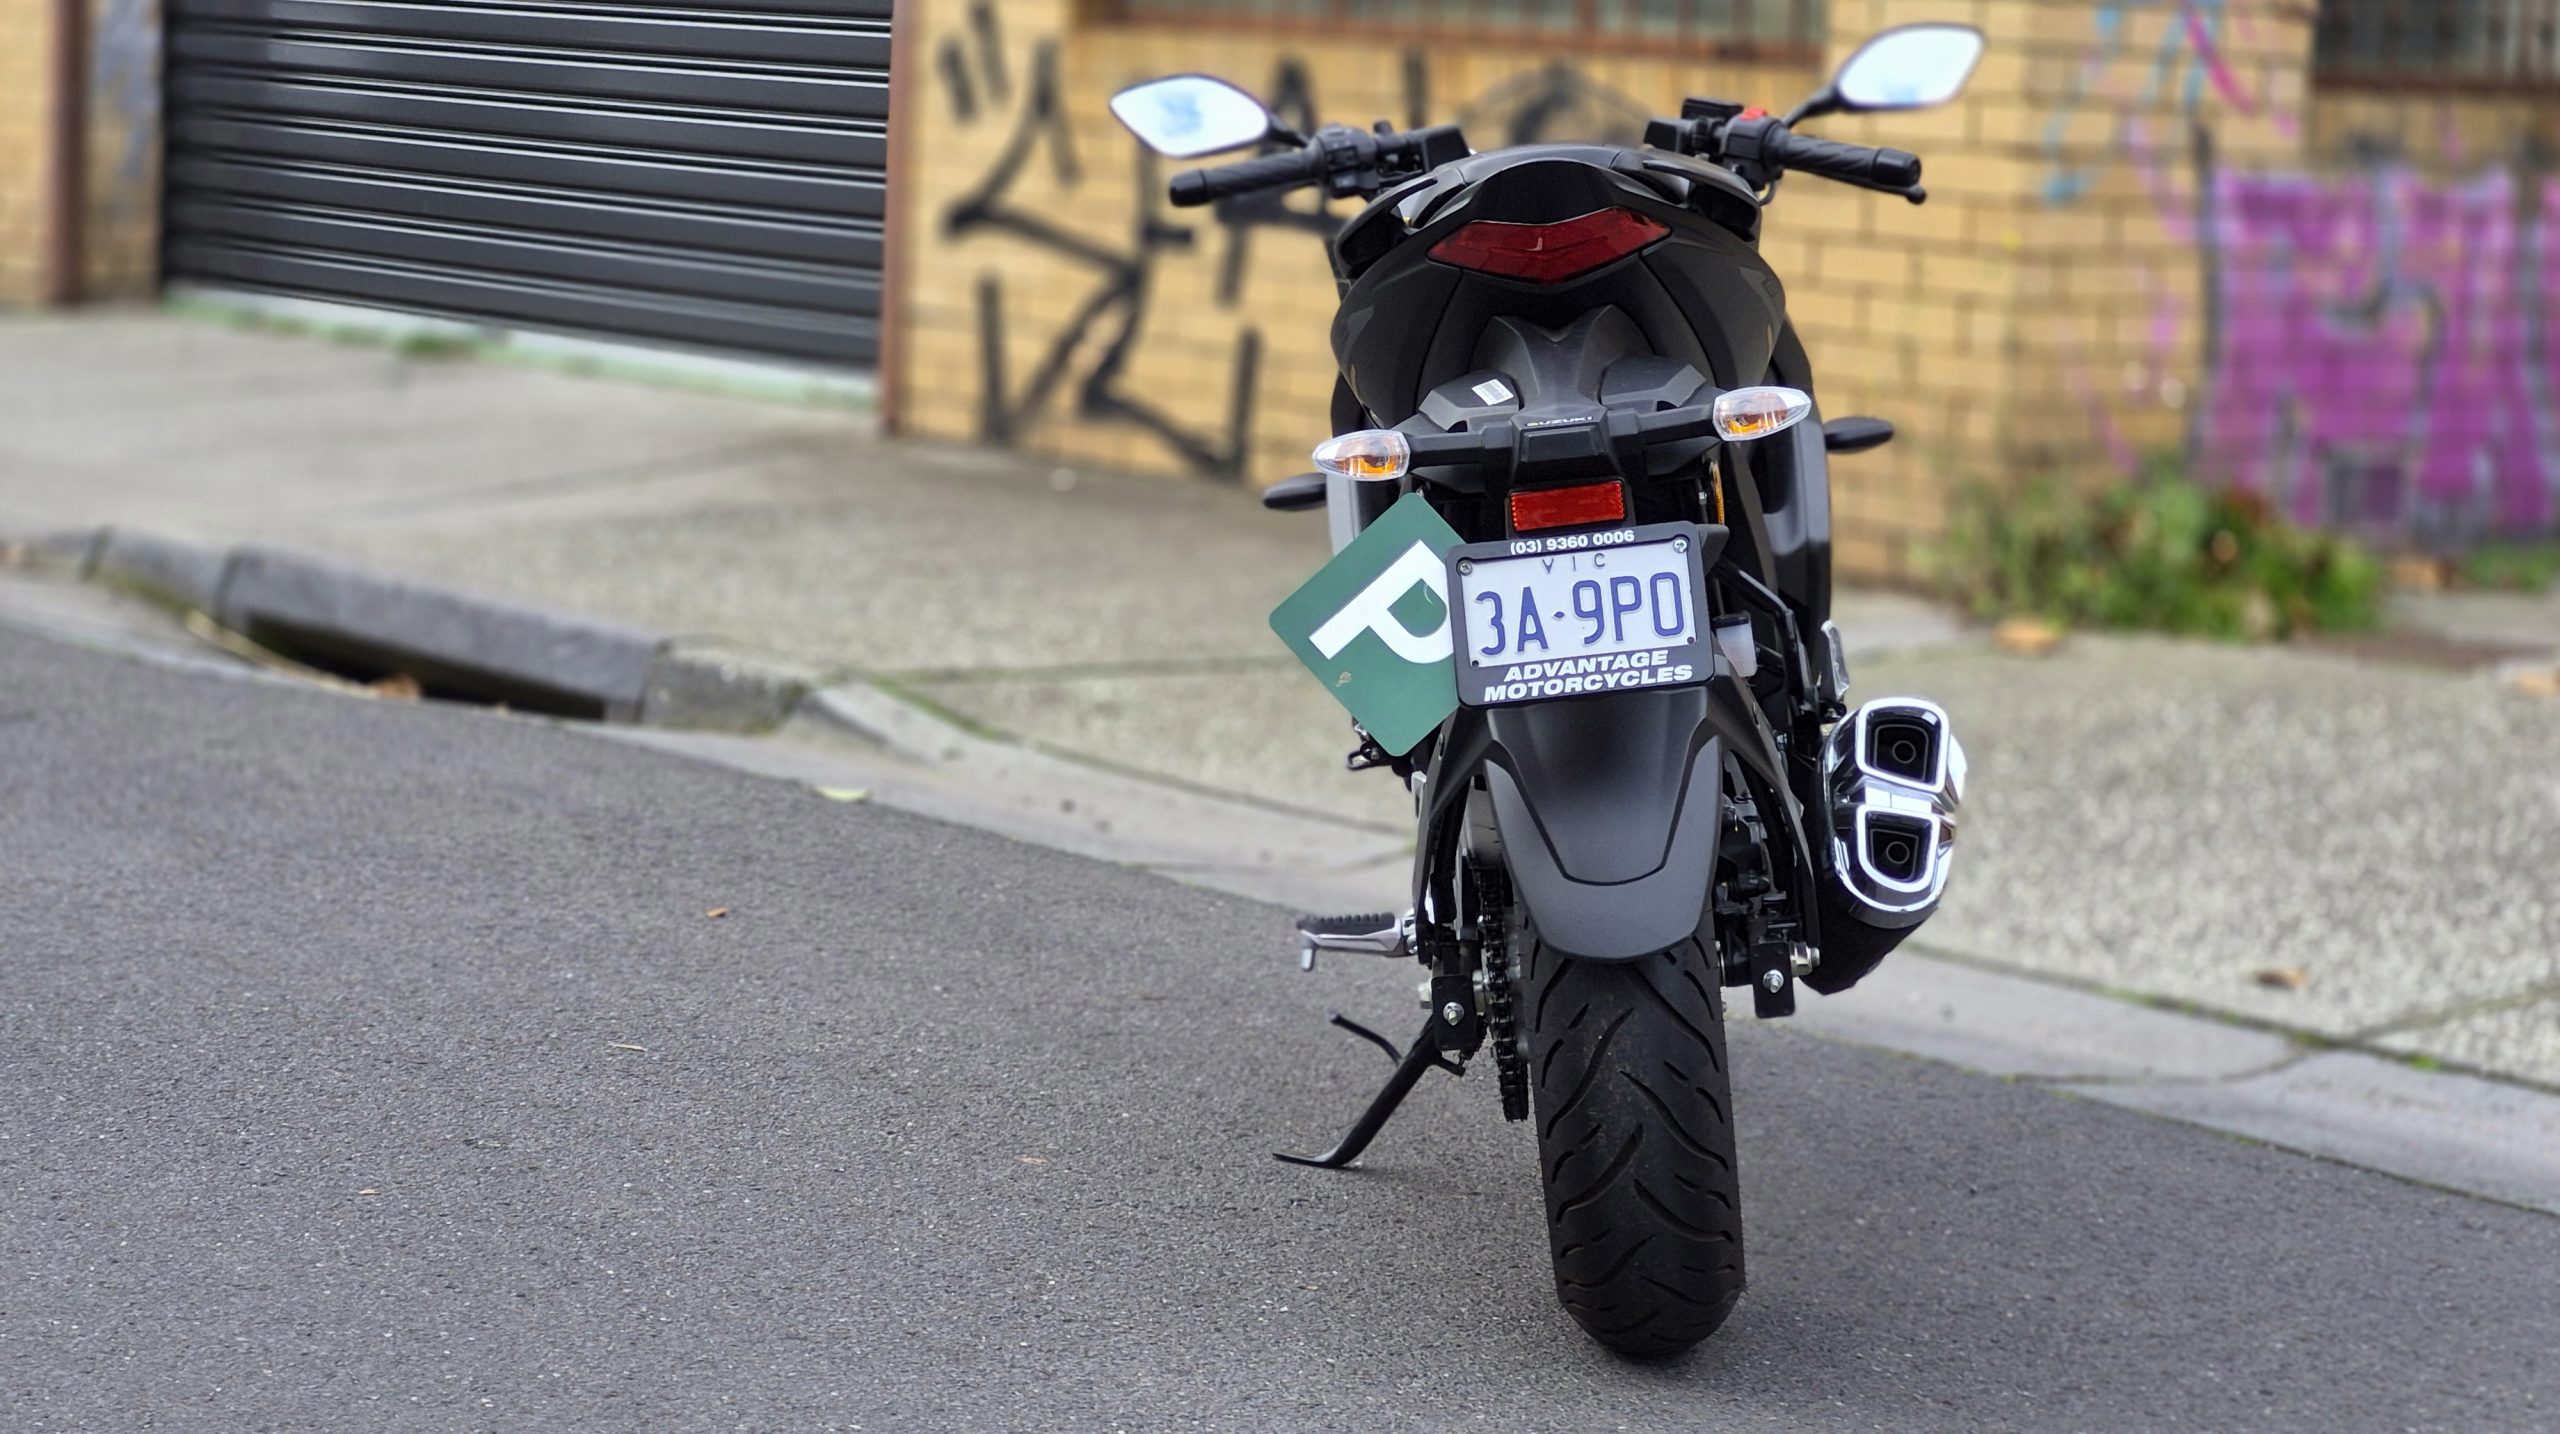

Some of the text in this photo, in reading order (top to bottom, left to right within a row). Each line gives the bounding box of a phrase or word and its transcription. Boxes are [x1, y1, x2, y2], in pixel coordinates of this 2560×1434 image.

[1525, 416, 1593, 427] SUZUKI
[1510, 529, 1635, 556] (03) 9360 0006
[1542, 553, 1606, 575] VIC
[1309, 538, 1454, 664] P
[1504, 650, 1668, 683] ADVANTAGE
[1484, 665, 1693, 702] MOTORCYCLES
